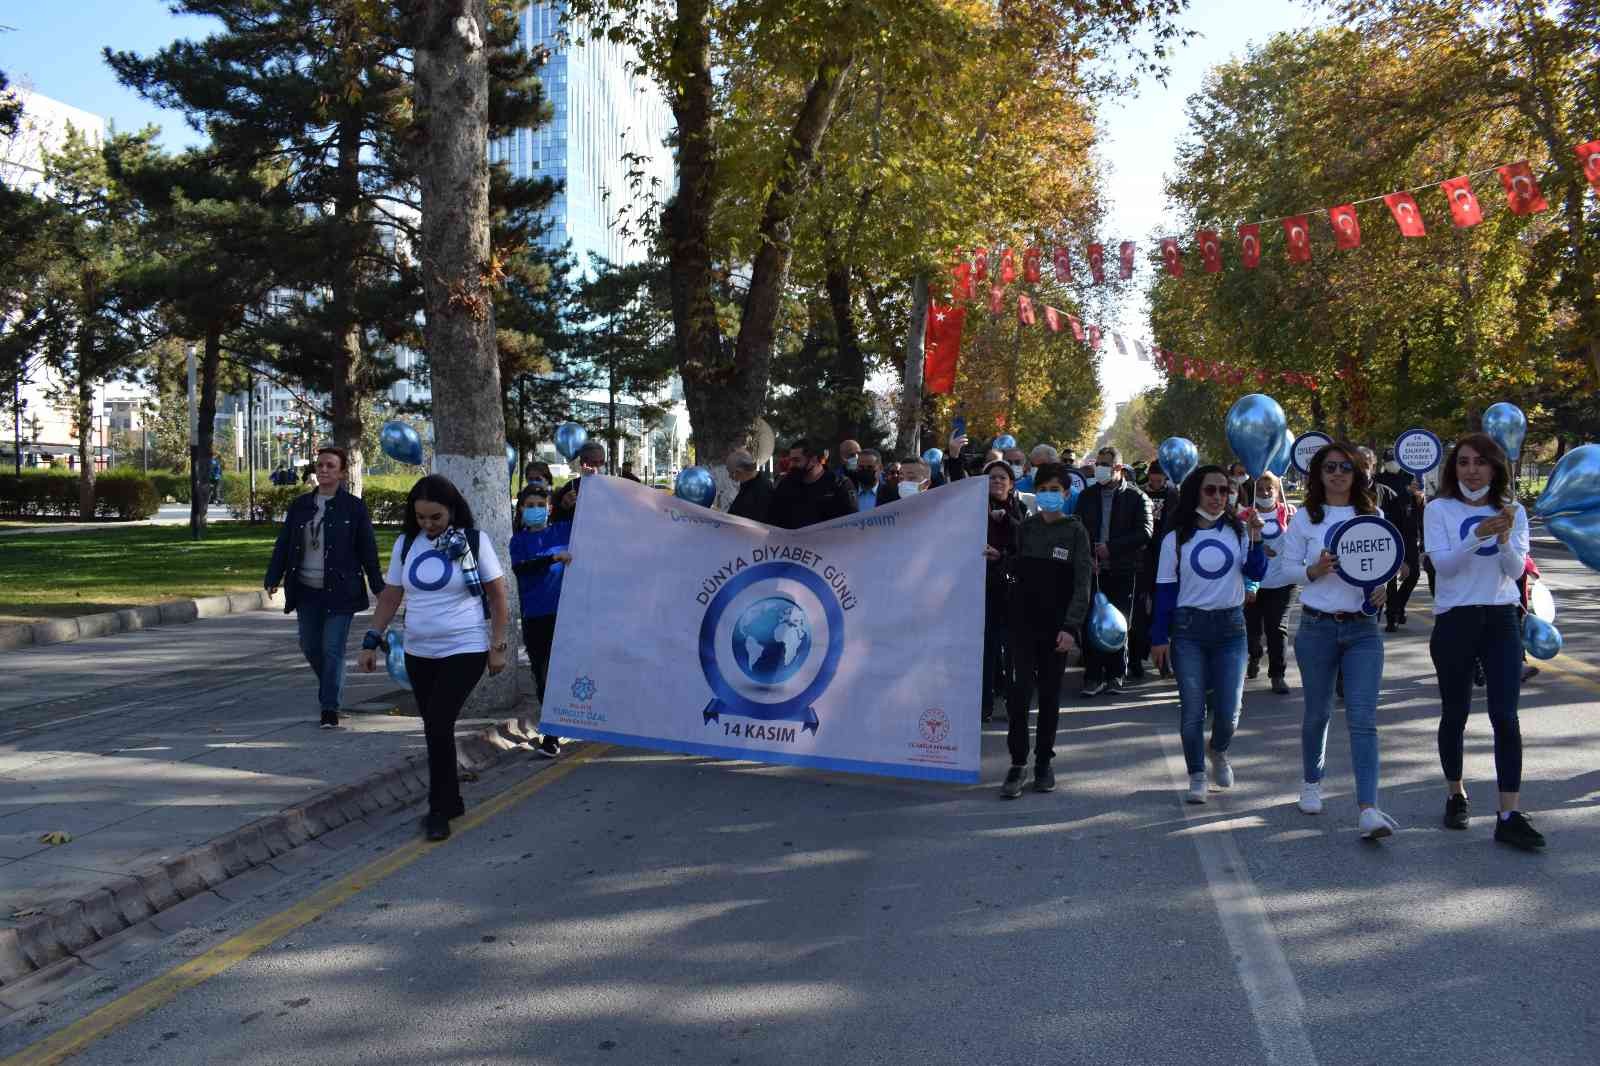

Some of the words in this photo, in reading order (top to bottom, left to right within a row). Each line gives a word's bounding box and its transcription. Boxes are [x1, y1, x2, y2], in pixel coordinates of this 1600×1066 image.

[1340, 537, 1392, 554] HAREKET
[1360, 558, 1374, 572] ET
[695, 556, 748, 606] DÜNYA
[752, 545, 823, 569] DİYABET
[823, 565, 857, 611] GÜNÜ
[723, 722, 741, 737] 14
[744, 724, 796, 743] KASIM
